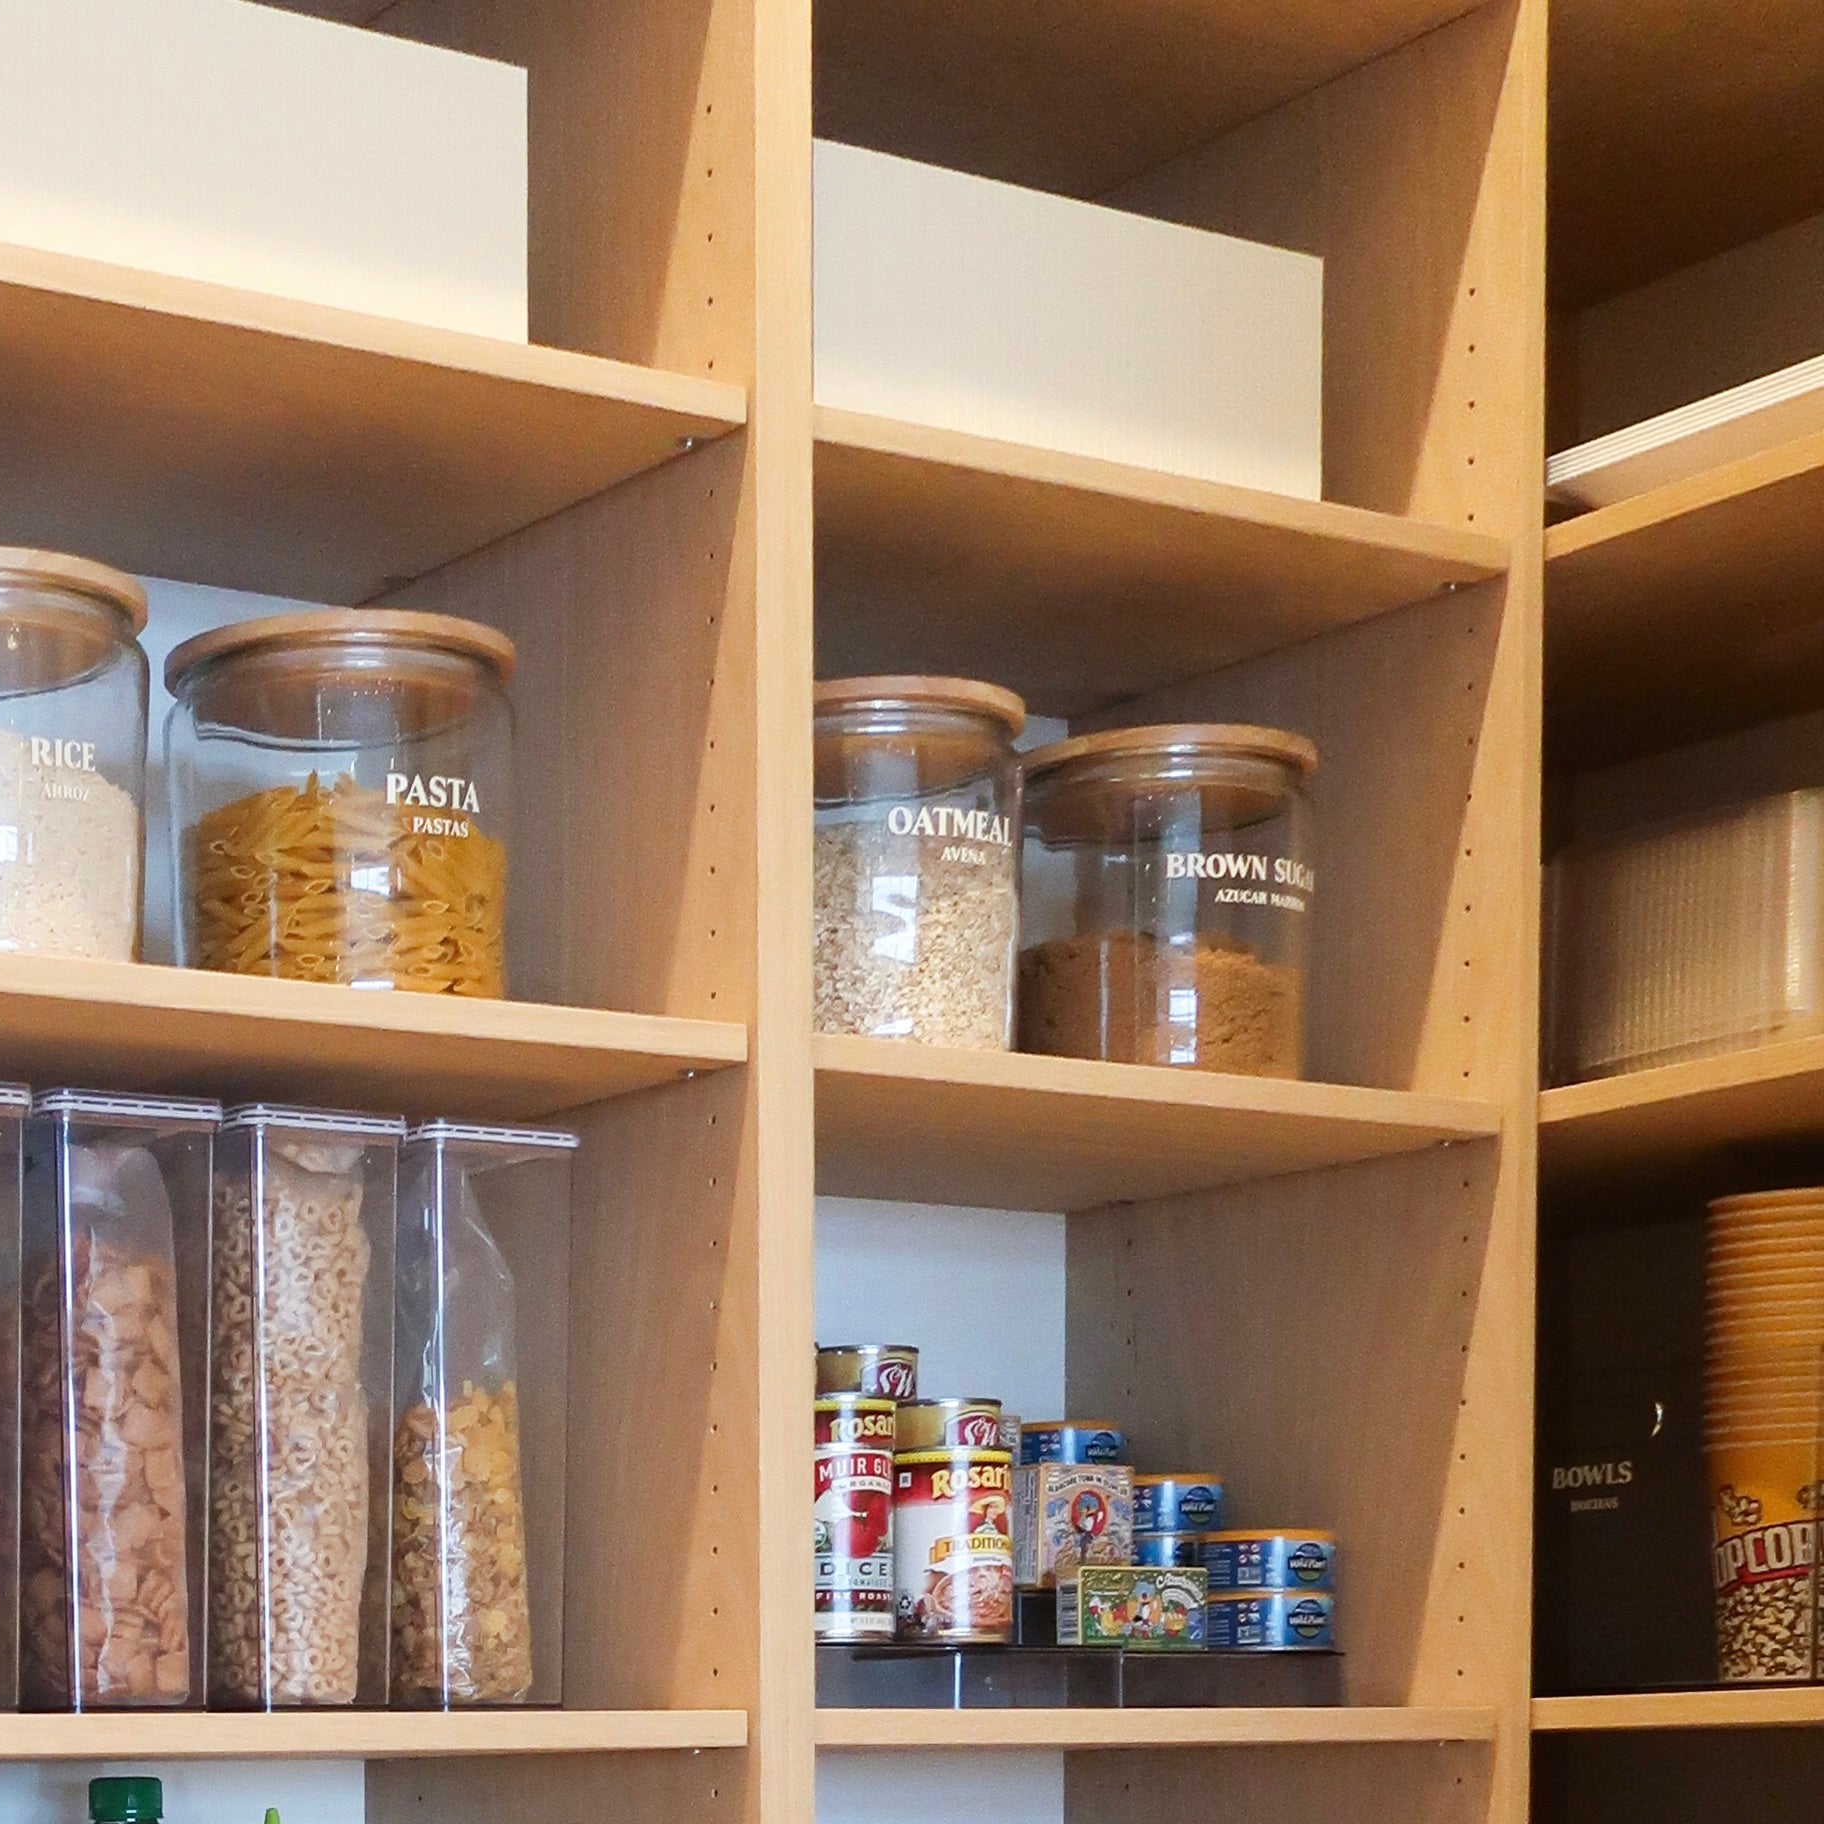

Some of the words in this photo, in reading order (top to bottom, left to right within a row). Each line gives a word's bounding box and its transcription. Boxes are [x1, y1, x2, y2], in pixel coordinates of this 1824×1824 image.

[30, 736, 96, 772] RICE
[386, 773, 480, 813] PASTA
[413, 816, 469, 838] PASTAS
[888, 805, 1012, 847] OATMEAL
[939, 845, 986, 865] AVENA
[1166, 853, 1268, 881] BROWN
[1215, 888, 1267, 905] AZUCAR
[818, 1457, 867, 1482] MUIR
[1552, 1461, 1633, 1490] BOWLS
